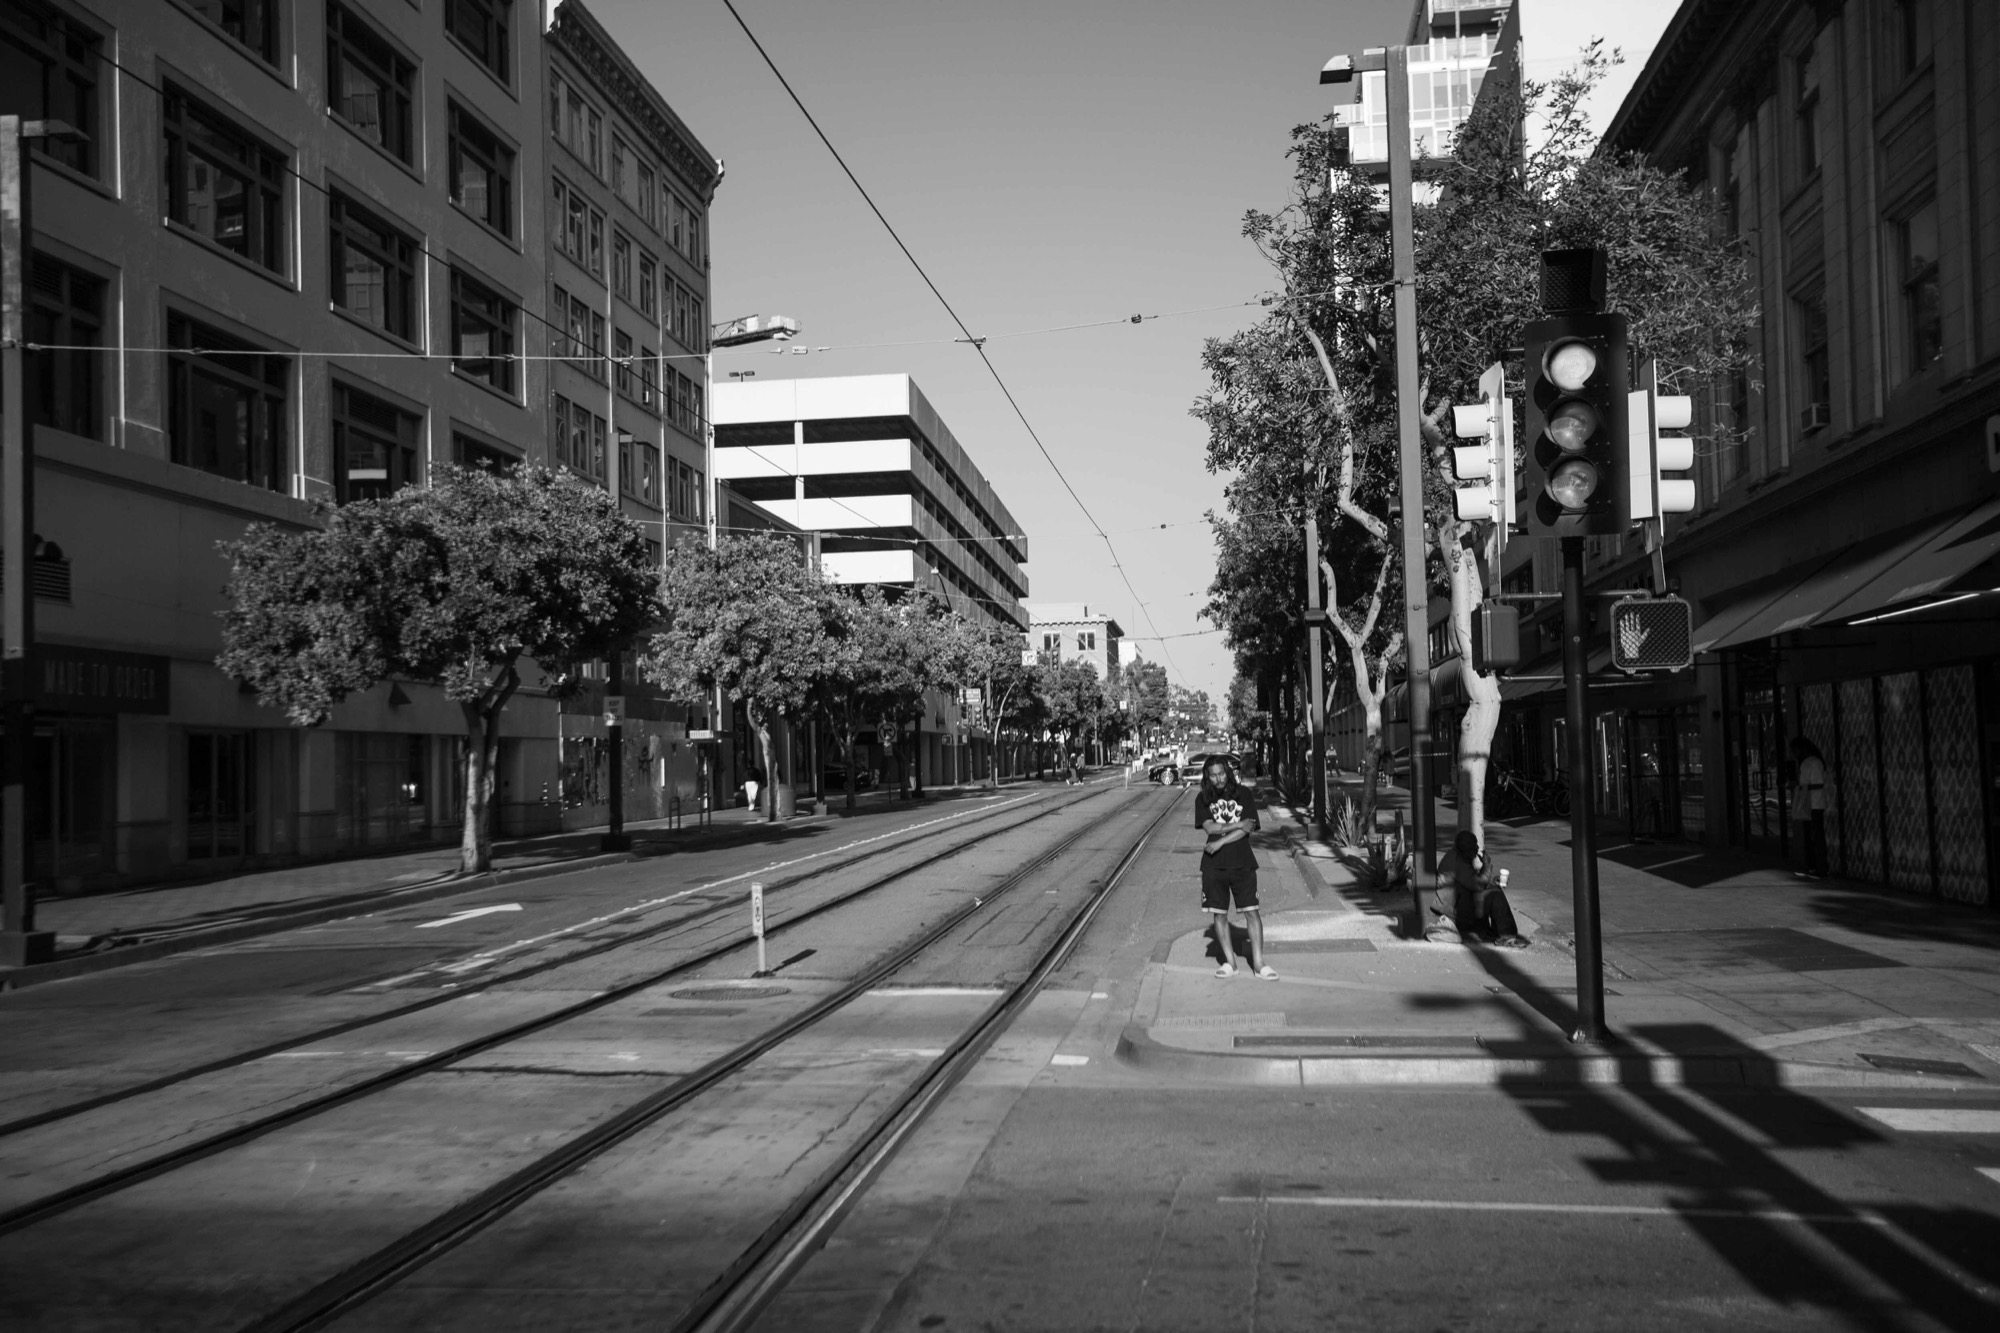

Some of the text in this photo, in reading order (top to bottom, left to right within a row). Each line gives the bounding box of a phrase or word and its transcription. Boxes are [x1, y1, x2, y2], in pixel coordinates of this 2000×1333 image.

[44, 659, 155, 700] MADE TO ORDER
